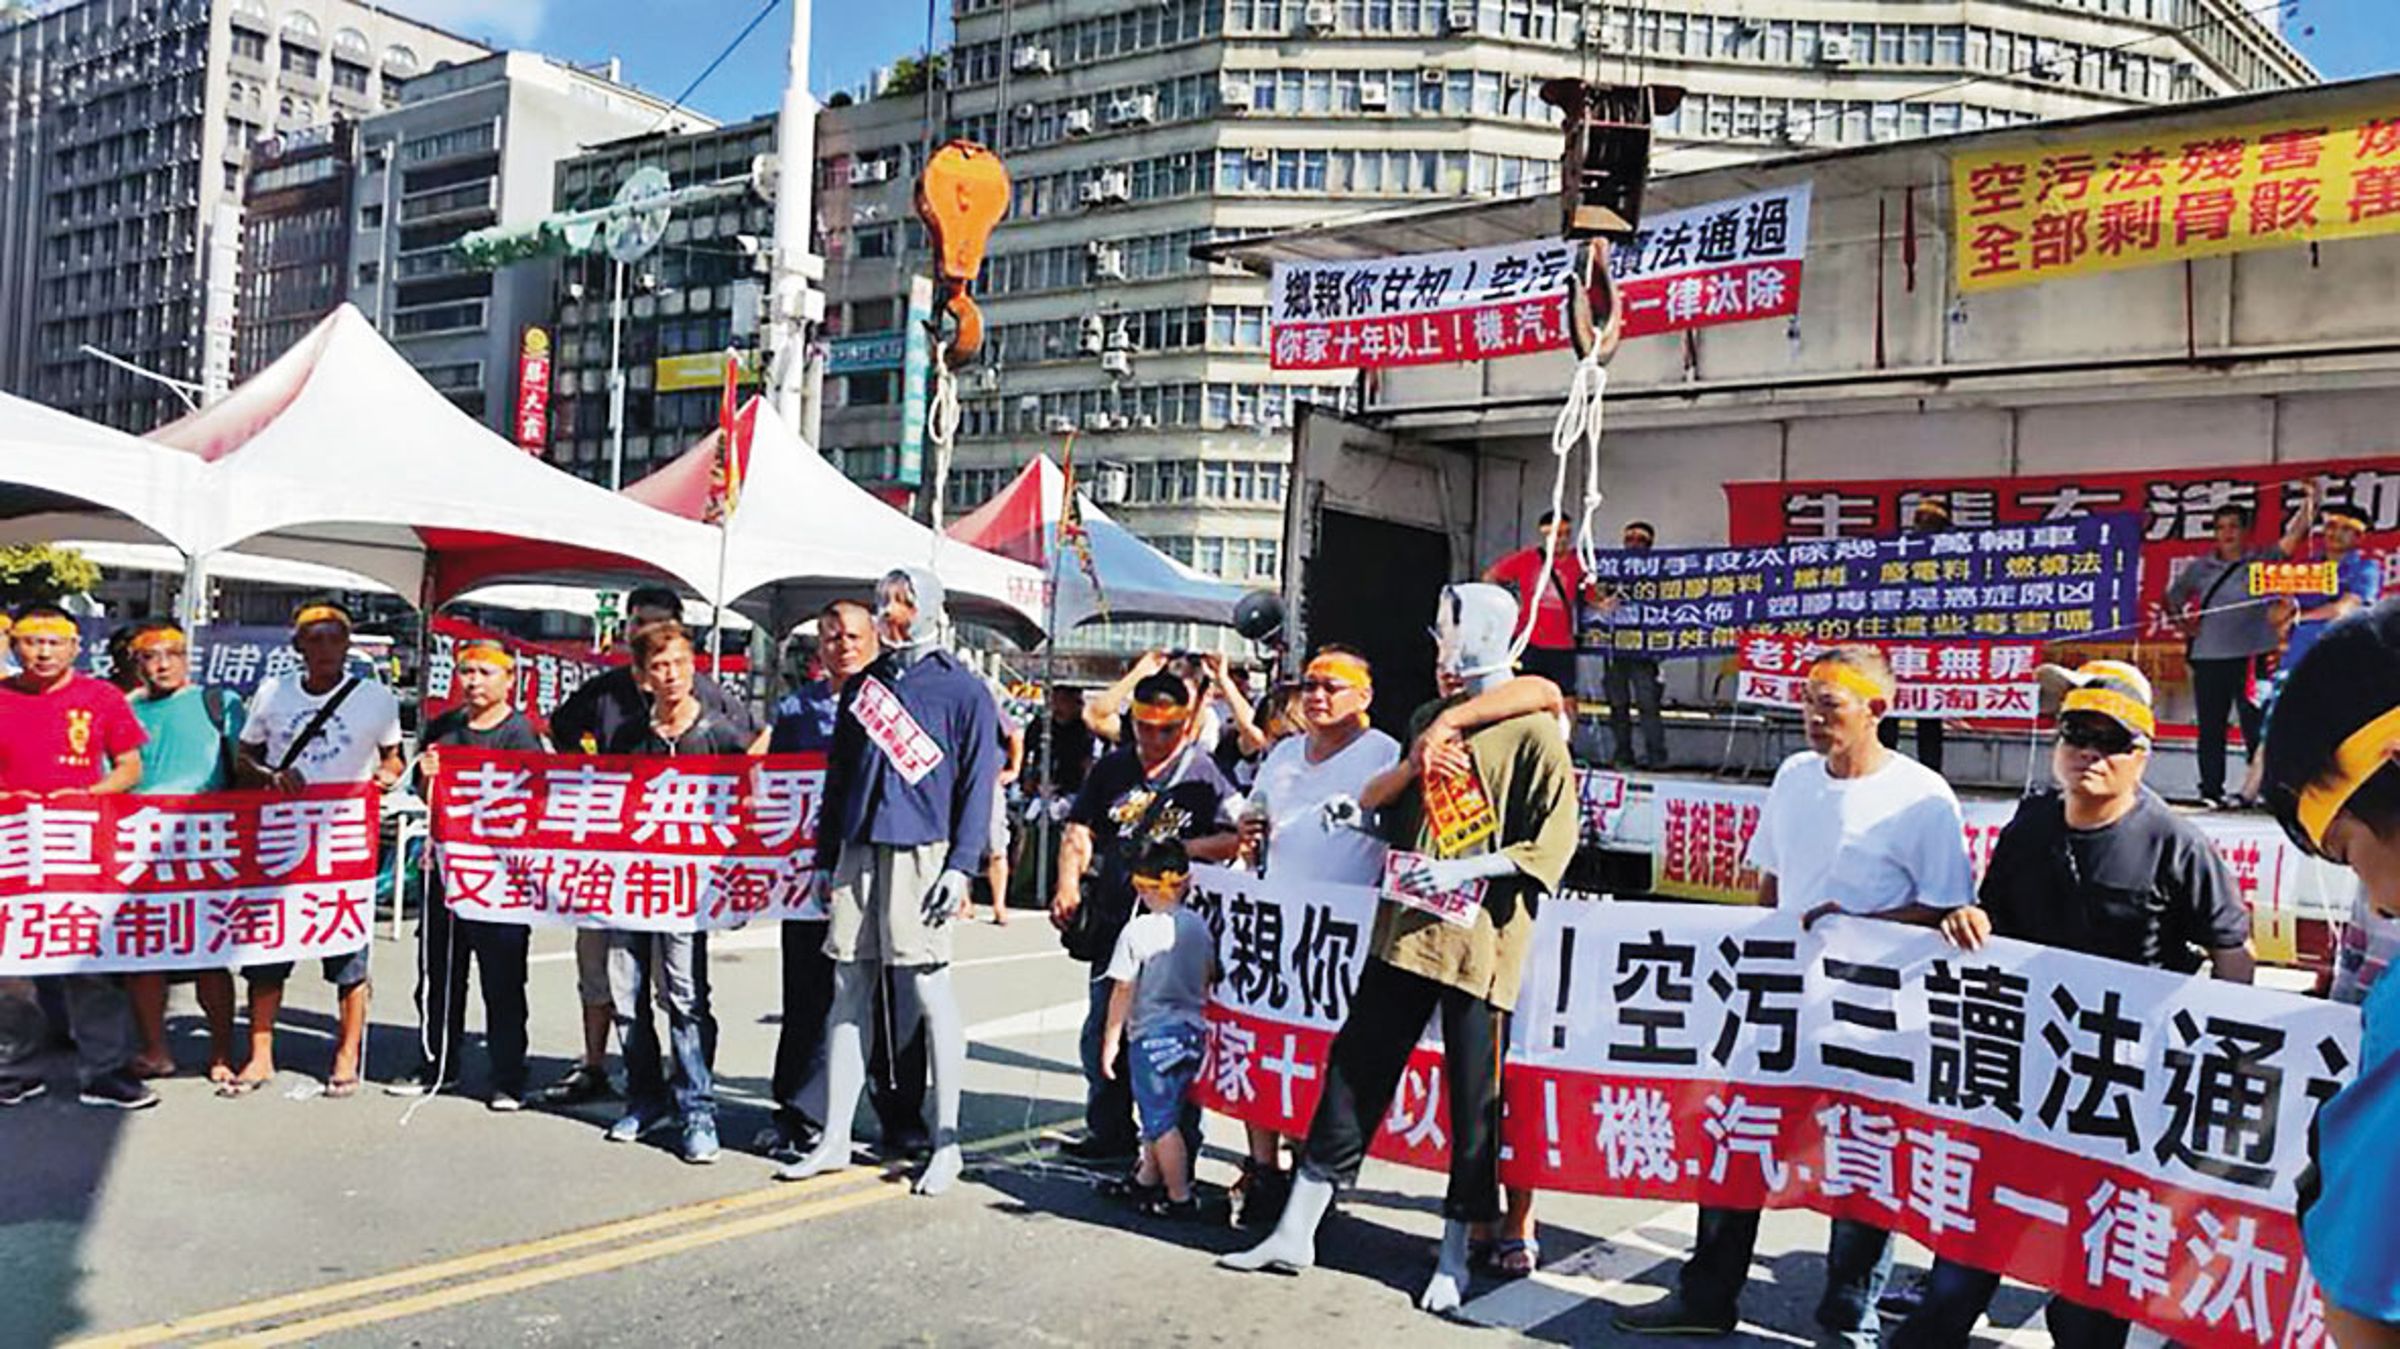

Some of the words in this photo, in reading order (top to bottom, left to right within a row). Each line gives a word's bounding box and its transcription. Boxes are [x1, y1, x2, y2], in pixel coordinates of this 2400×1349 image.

[1283, 197, 1788, 318] 鄉親你甘知！空污讀法通過
[1969, 178, 2321, 277] 全部剩骨骸
[446, 762, 826, 850] 老車無罪
